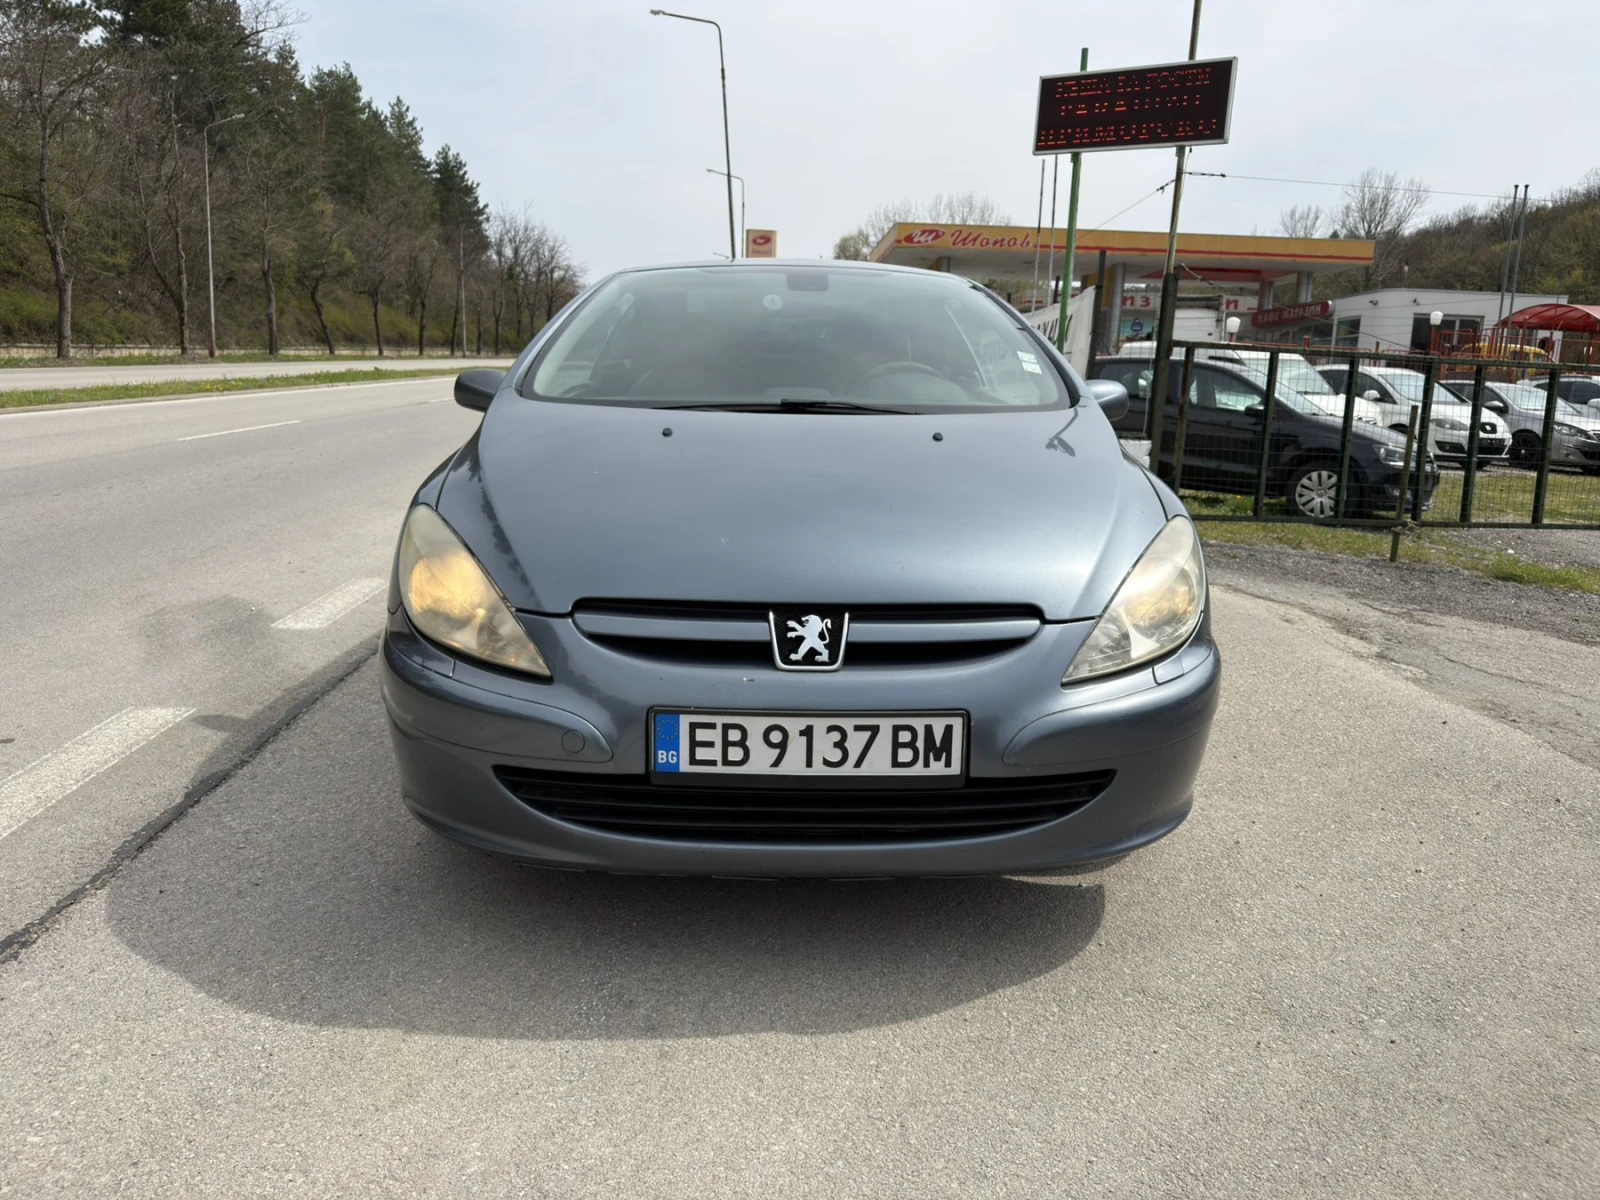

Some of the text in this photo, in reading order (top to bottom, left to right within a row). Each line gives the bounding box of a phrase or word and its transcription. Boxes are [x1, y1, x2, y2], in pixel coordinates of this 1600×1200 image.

[657, 750, 677, 763] BG
[688, 721, 954, 769] EB 9137 BM
